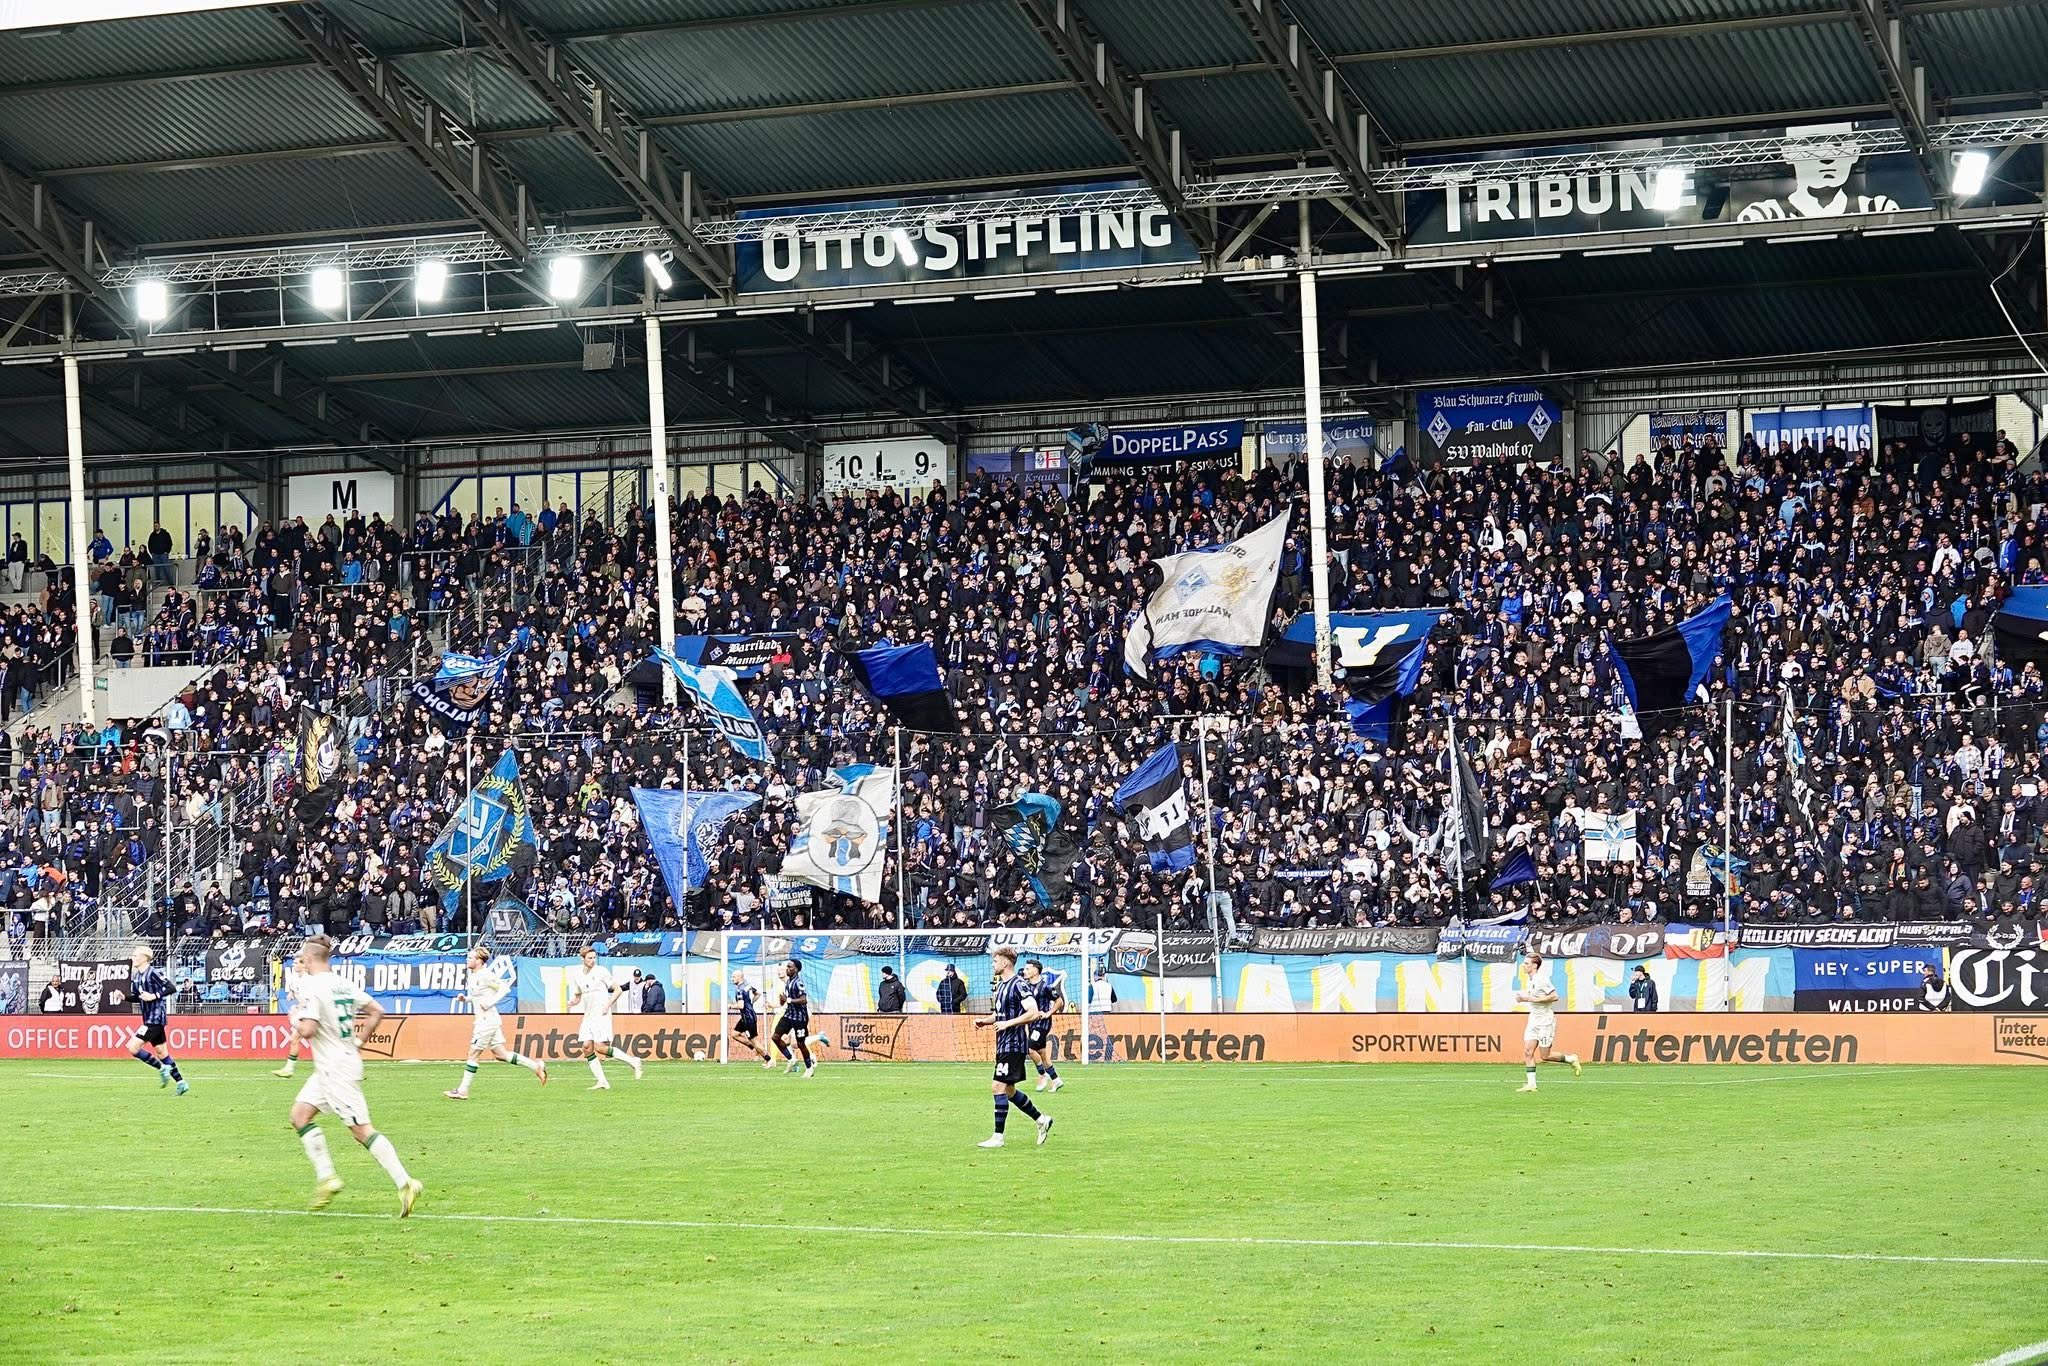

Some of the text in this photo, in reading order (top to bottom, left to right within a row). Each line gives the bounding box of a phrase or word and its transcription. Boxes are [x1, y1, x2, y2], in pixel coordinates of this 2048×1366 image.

[924, 208, 1172, 271] SIFFLING
[1330, 425, 1373, 441] Crew
[1521, 443, 1534, 458] 07
[914, 451, 930, 476] 9
[332, 480, 358, 510] M
[721, 654, 774, 665] Mannhei
[1741, 927, 1893, 944] KOLLEKTIV SECHS ACHT
[61, 963, 91, 982] DIRTY
[374, 963, 412, 992] DEN
[419, 962, 469, 991] VERE
[1814, 962, 1848, 976] HEY
[1866, 960, 1926, 976] SUPER
[1828, 998, 1915, 1012] WALDHOF
[844, 1016, 875, 1034] inter
[1999, 1017, 2037, 1034] inter
[7, 1028, 79, 1050] OFFICE
[169, 1028, 243, 1050] OFFICE
[514, 1016, 721, 1060] intewetten
[847, 1033, 890, 1046] wetten
[1046, 1028, 1266, 1062] nterwetten
[1352, 1034, 1501, 1053] SPORTWETTEN
[1592, 1015, 1859, 1063] interwetten
